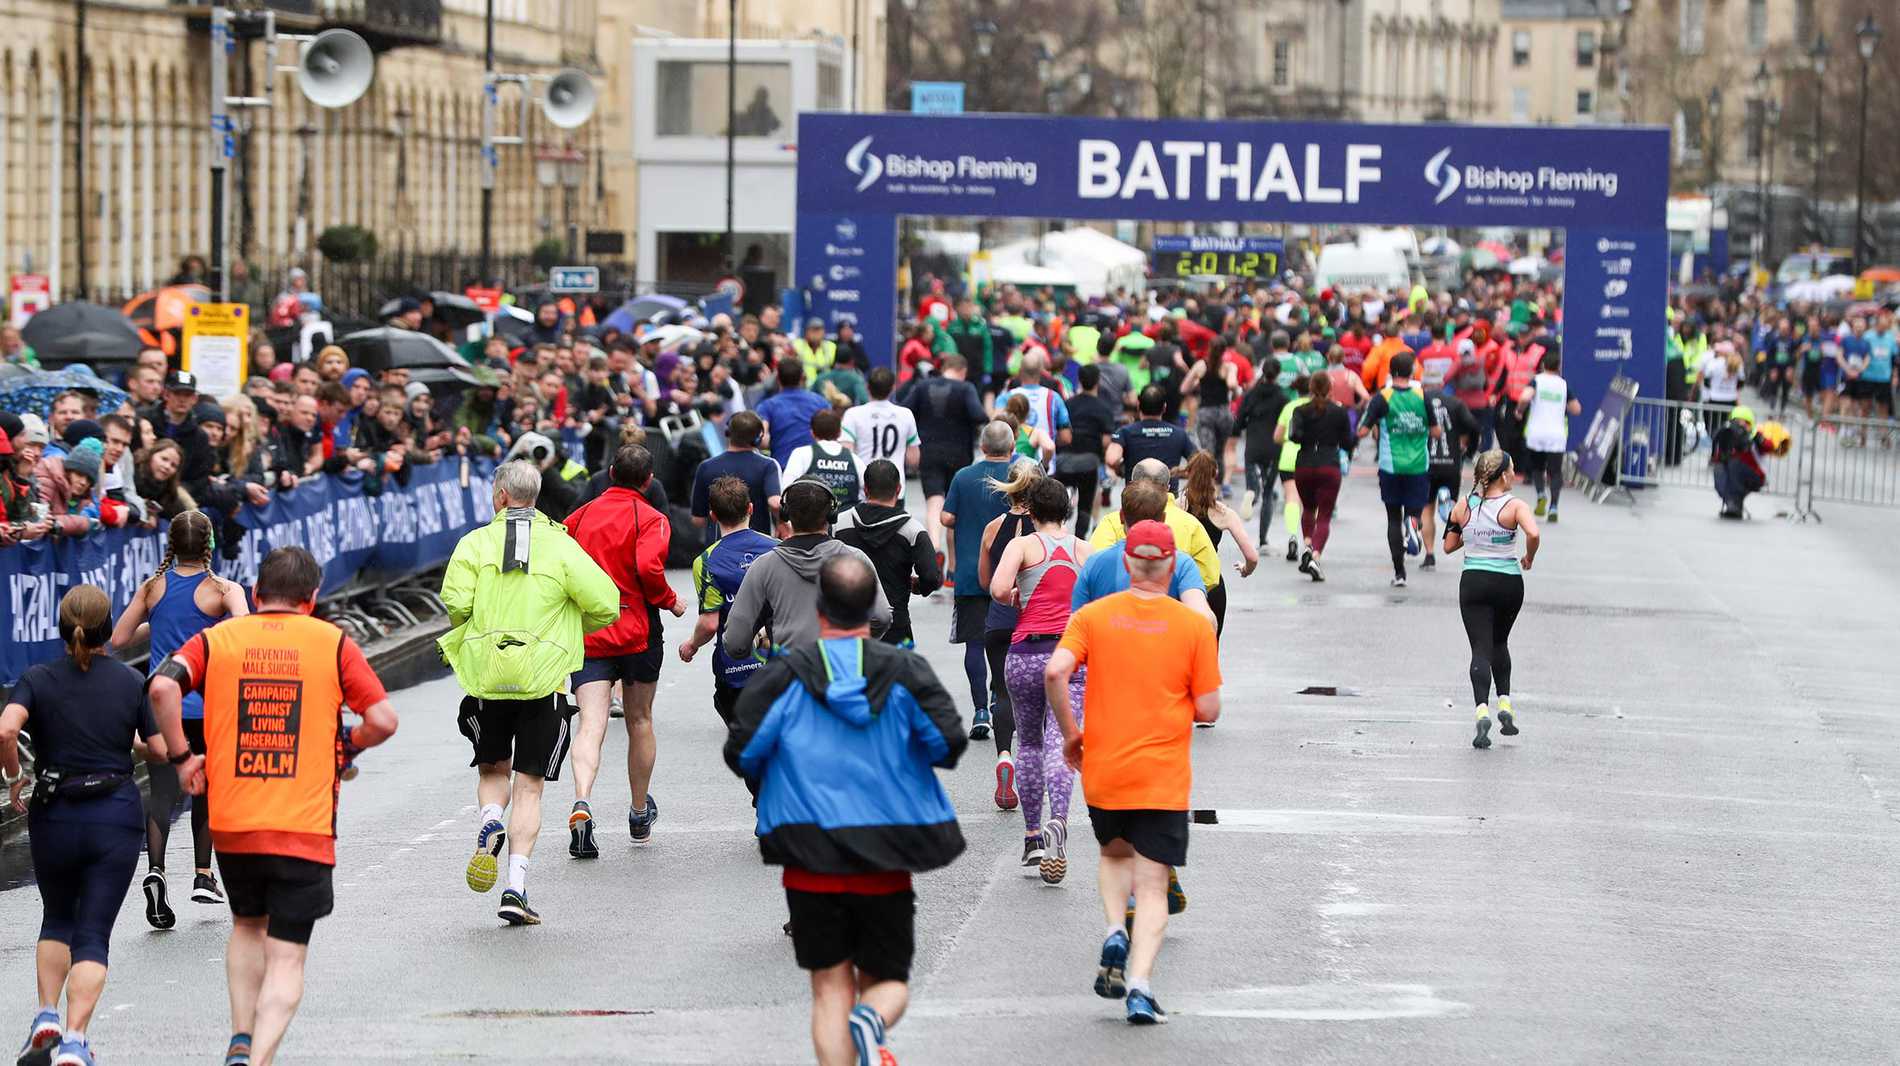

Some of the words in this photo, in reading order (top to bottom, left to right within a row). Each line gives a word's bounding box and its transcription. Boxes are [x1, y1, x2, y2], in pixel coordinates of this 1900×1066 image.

[886, 154, 955, 183] Bishop
[957, 155, 1037, 186] Fleming
[1077, 138, 1383, 204] BATHALF
[1465, 164, 1534, 194] Bishop
[1537, 166, 1618, 197] Fleming
[872, 423, 899, 459] 10
[816, 458, 849, 471] CLACKY
[245, 648, 299, 661] PREVENTING
[242, 661, 265, 674] MALE
[268, 662, 300, 676] SUICIDE
[243, 686, 297, 701] CAMPAIGN
[247, 701, 292, 717] AGAINST
[252, 717, 286, 732] LIVING
[240, 732, 296, 748] MISERABLY
[238, 751, 294, 775] CALM
